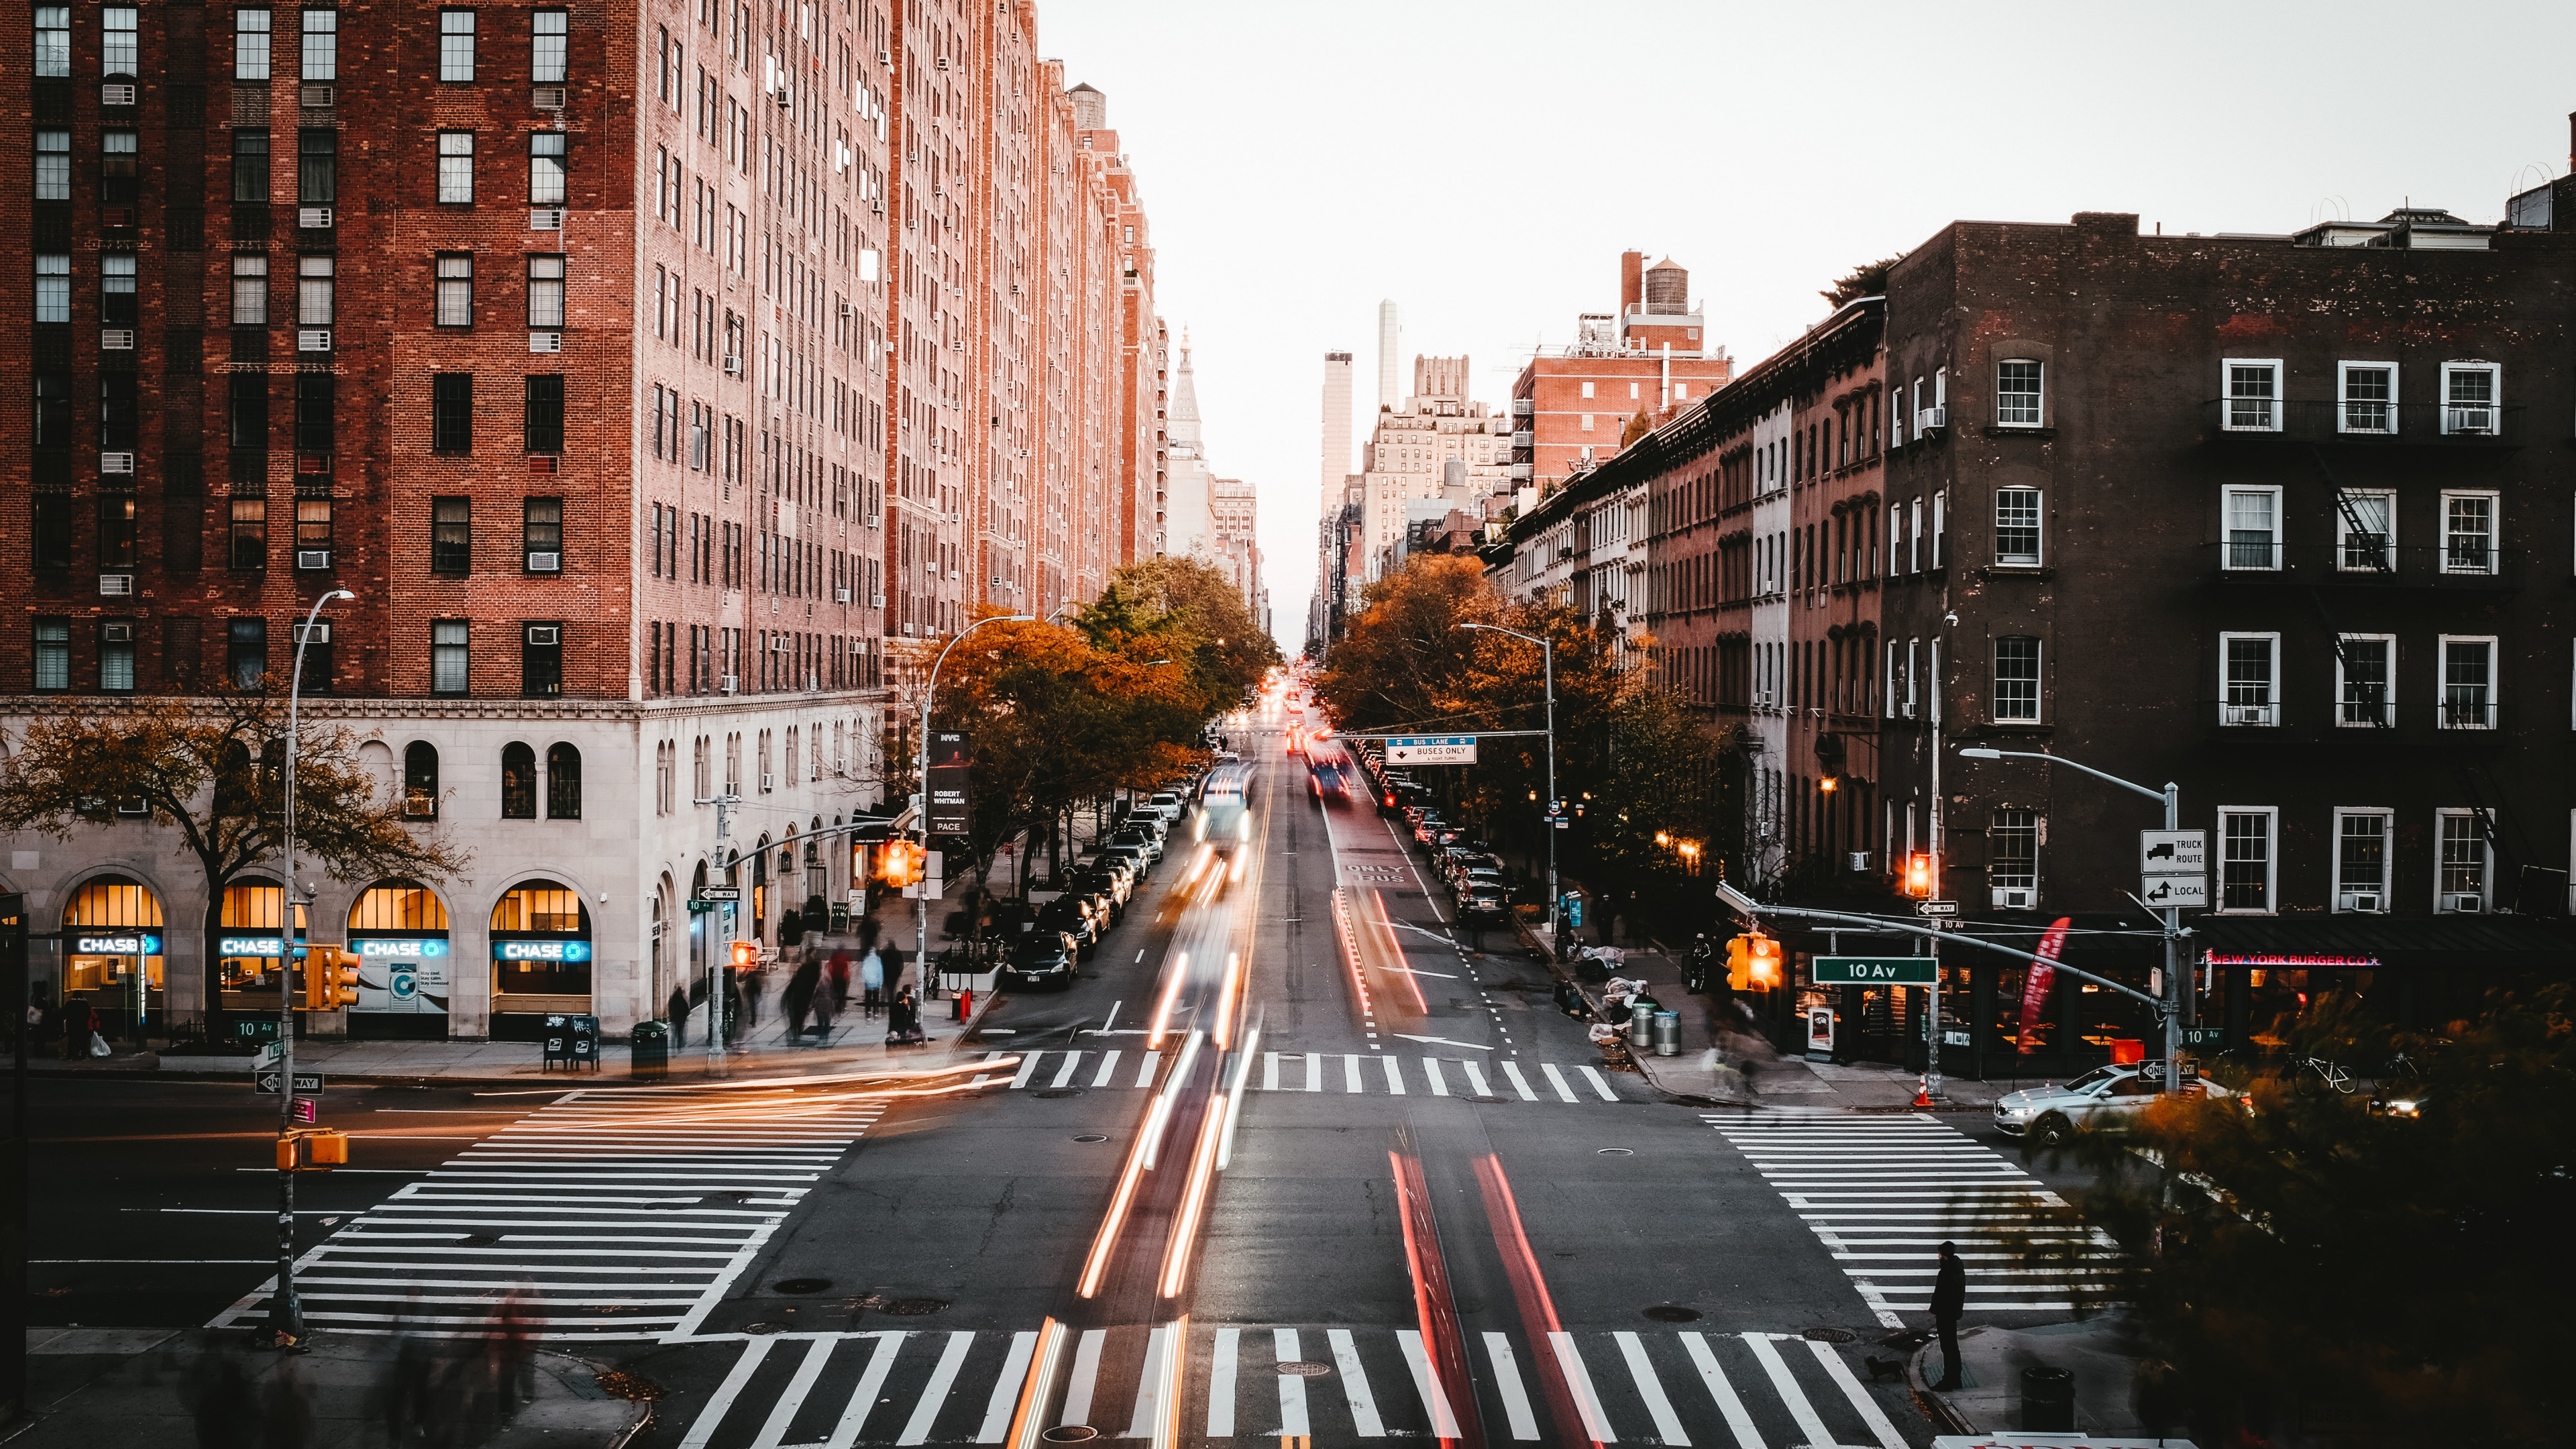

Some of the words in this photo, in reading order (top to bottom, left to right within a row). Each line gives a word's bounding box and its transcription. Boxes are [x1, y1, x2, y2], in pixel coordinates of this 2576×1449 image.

[941, 734, 960, 742] NYC
[2176, 840, 2202, 849] TRUCK
[2176, 855, 2202, 863] ROUTE
[2174, 886, 2204, 896] LOCAL
[690, 901, 700, 910] 10
[79, 938, 138, 952] CHASE
[221, 940, 280, 953] CHASE
[364, 943, 421, 956] CHASE
[505, 945, 563, 957] CHASE
[2212, 955, 2245, 965] NEW
[2249, 955, 2286, 965] YORK
[2289, 955, 2345, 965] BURGER
[2347, 955, 2367, 965] CO
[1849, 964, 1867, 977] 10
[1872, 964, 1896, 977] Av
[239, 1023, 254, 1035] 10
[2188, 1030, 2202, 1042] 10
[274, 1043, 280, 1057] 23
[2147, 1066, 2165, 1075] ONE
[2179, 1065, 2192, 1074] AY
[266, 1078, 280, 1087] ON
[294, 1078, 315, 1088] WAY
